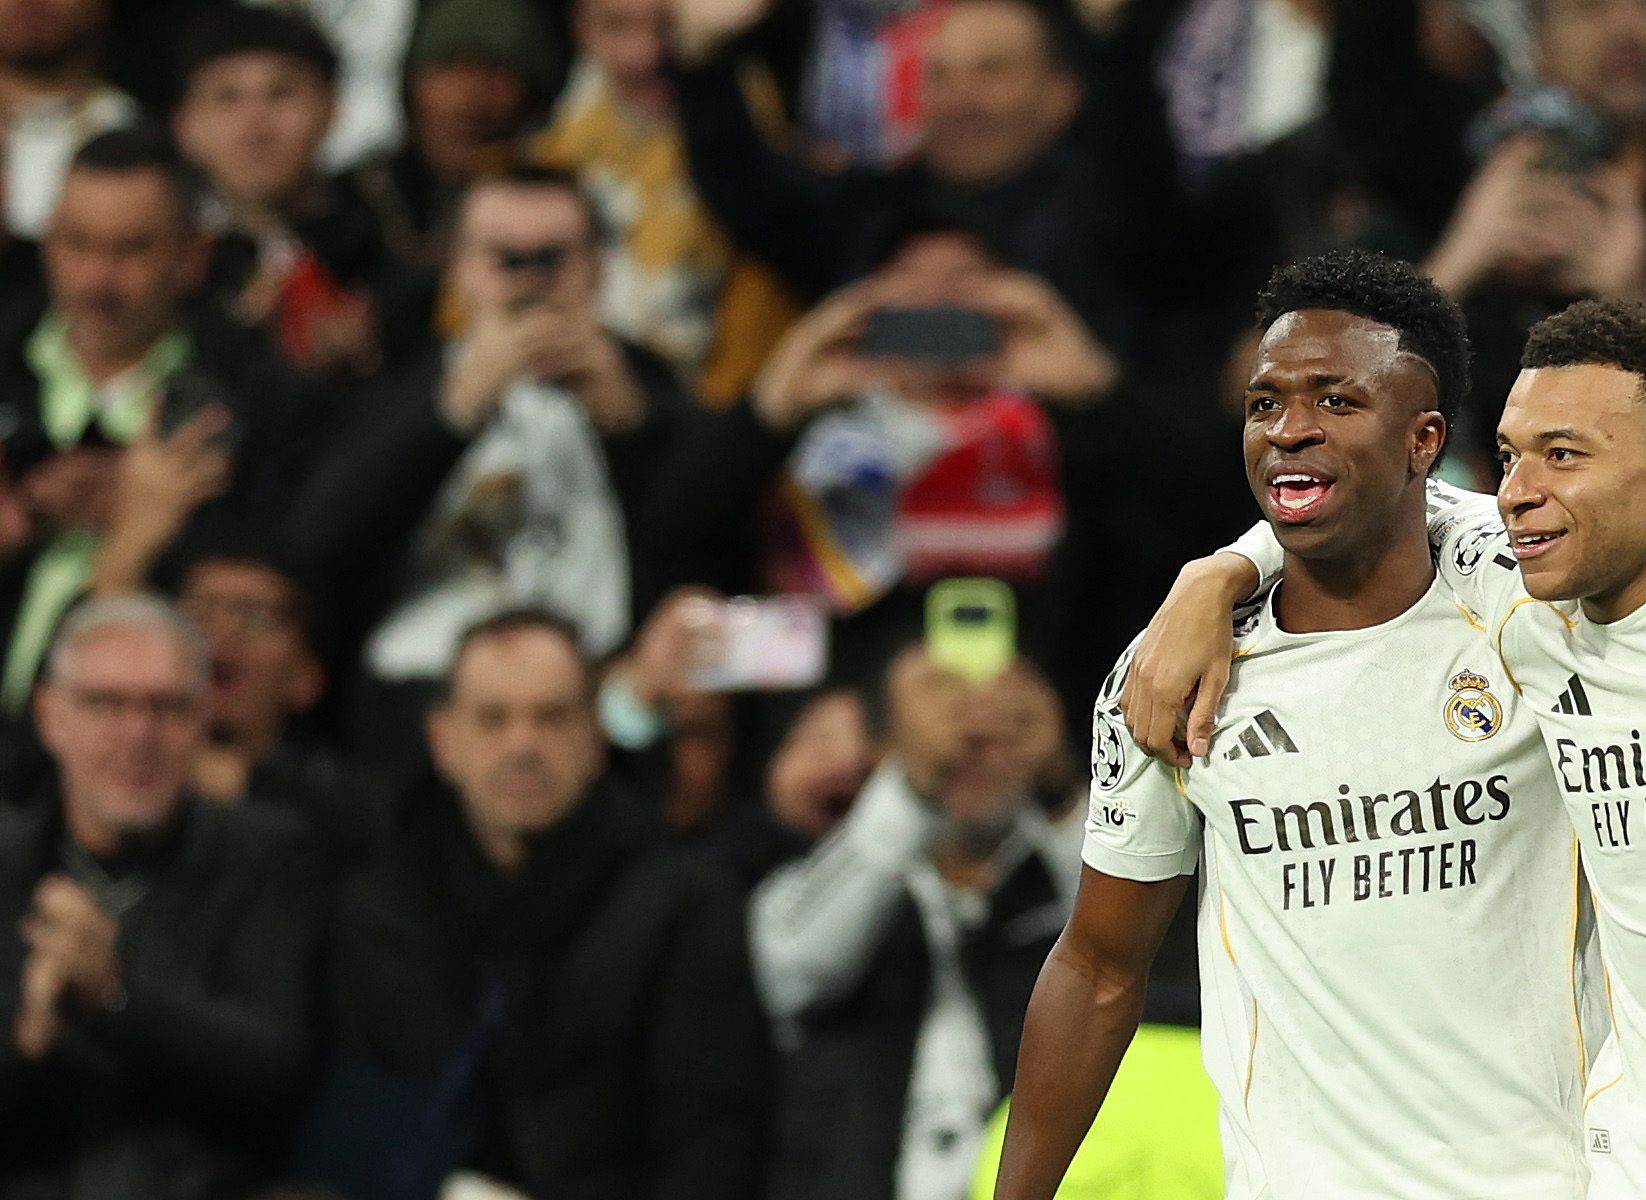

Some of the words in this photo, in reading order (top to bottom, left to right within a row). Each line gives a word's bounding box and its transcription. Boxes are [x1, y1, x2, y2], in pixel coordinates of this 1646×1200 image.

[1228, 774, 1511, 855] Emirates
[1591, 800, 1630, 848] FLY
[1283, 858, 1336, 910] FLY
[1353, 838, 1477, 902] BETTER
